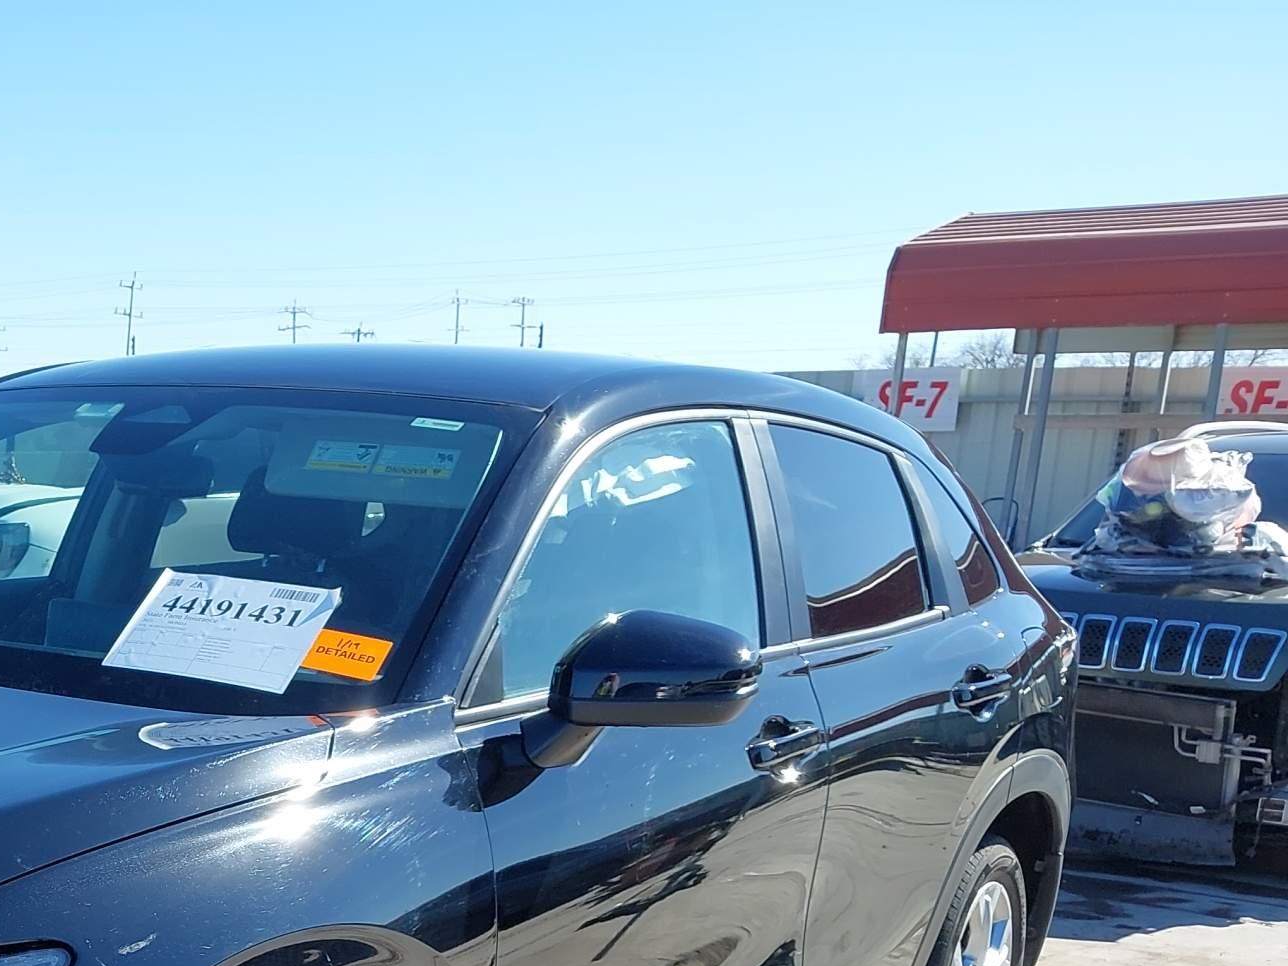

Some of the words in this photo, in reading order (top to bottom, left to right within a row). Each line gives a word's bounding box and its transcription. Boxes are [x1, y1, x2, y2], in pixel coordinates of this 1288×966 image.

[879, 380, 949, 418] SF-7
[162, 594, 303, 627] 44191431
[315, 645, 376, 664] DETAILED
